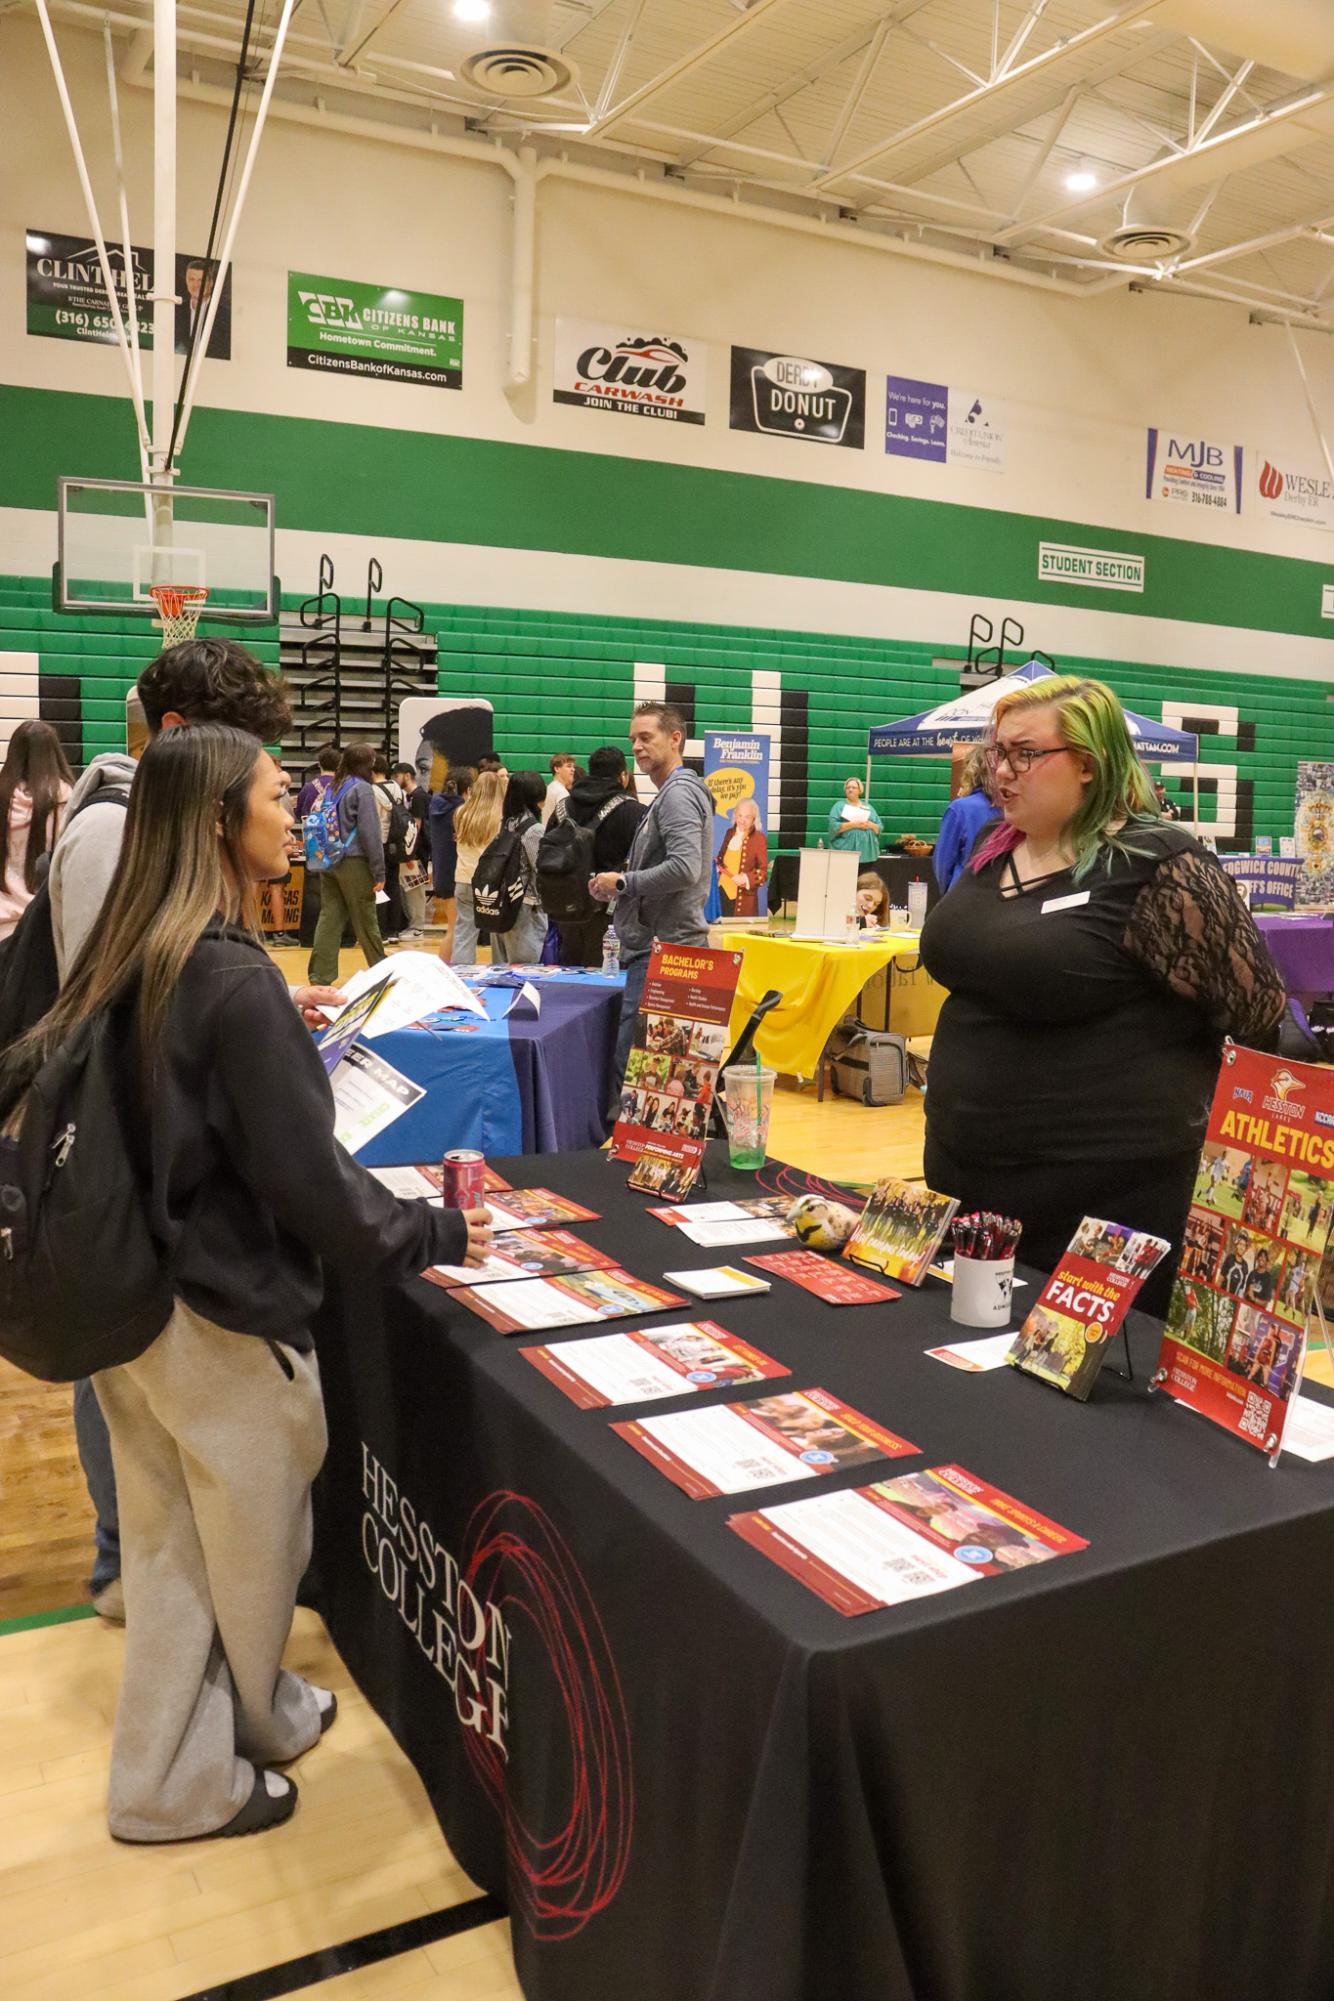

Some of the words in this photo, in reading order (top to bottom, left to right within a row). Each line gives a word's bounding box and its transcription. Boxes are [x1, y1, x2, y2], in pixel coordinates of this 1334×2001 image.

[37, 258, 102, 285] CLINT
[55, 309, 89, 328] (316)
[362, 308, 418, 329] CITIZENS
[422, 317, 456, 335] BANK
[319, 331, 372, 347] Hometown
[374, 339, 437, 357] Commitment.
[398, 328, 456, 342] KANSAS
[307, 354, 447, 383] CitizensBankofKansas.com
[576, 346, 687, 394] Club
[574, 382, 684, 407] CARWASH
[771, 388, 837, 421] DONUT
[888, 391, 907, 403] We're
[908, 394, 922, 405] here
[583, 396, 613, 409] JOIN
[617, 401, 640, 413] THE
[643, 405, 678, 420] CLUB!
[1167, 438, 1224, 469] MJB
[1285, 473, 1334, 499] WESLE
[1042, 554, 1093, 576] STUDENT
[1096, 561, 1142, 582] SECTION
[713, 738, 760, 751] Benjamin
[720, 749, 763, 761] Franklin
[874, 738, 897, 748] PEOPLE
[898, 738, 910, 747] ARE
[912, 738, 920, 747] AT
[921, 737, 934, 746] THE
[1222, 860, 1266, 876] EDGWICK
[1266, 881, 1294, 899] OFFICE
[476, 906, 500, 916] adidas
[659, 966, 699, 979] PROGRAMS
[661, 953, 715, 971] BACHELOR'S
[1262, 1095, 1306, 1119] HESSTON
[1219, 1109, 1334, 1169] ATHLETICS
[1057, 1271, 1082, 1287] start
[1081, 1278, 1105, 1295] with
[1103, 1286, 1121, 1302] the
[1046, 1280, 1115, 1323] FACTS
[361, 1441, 511, 1690] HESSTON
[362, 1512, 508, 1764] COLLEGE
